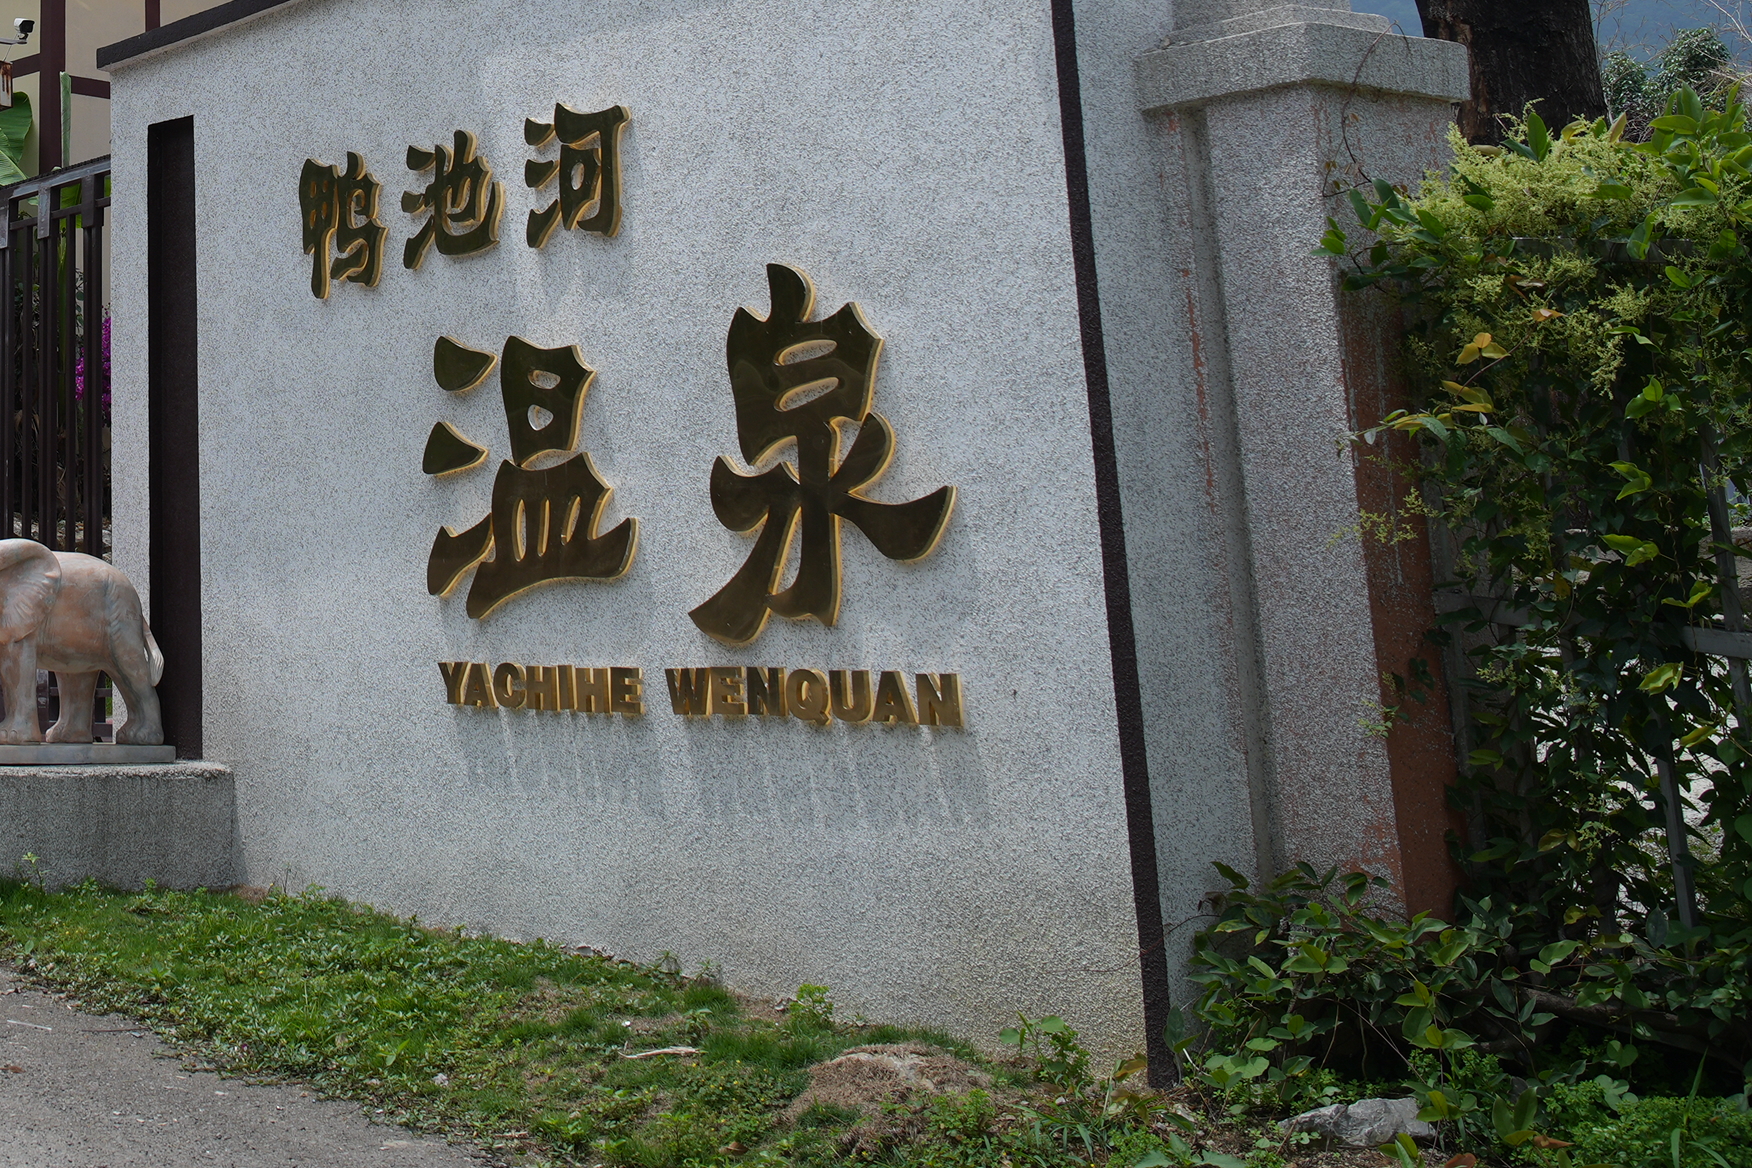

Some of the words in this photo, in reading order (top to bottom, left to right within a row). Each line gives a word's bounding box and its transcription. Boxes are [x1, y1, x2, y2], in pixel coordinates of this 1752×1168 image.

[299, 102, 631, 299] 鸭池河
[422, 263, 957, 646] 温泉
[438, 662, 645, 715] YACHIHE
[665, 666, 964, 726] WENQUAN
